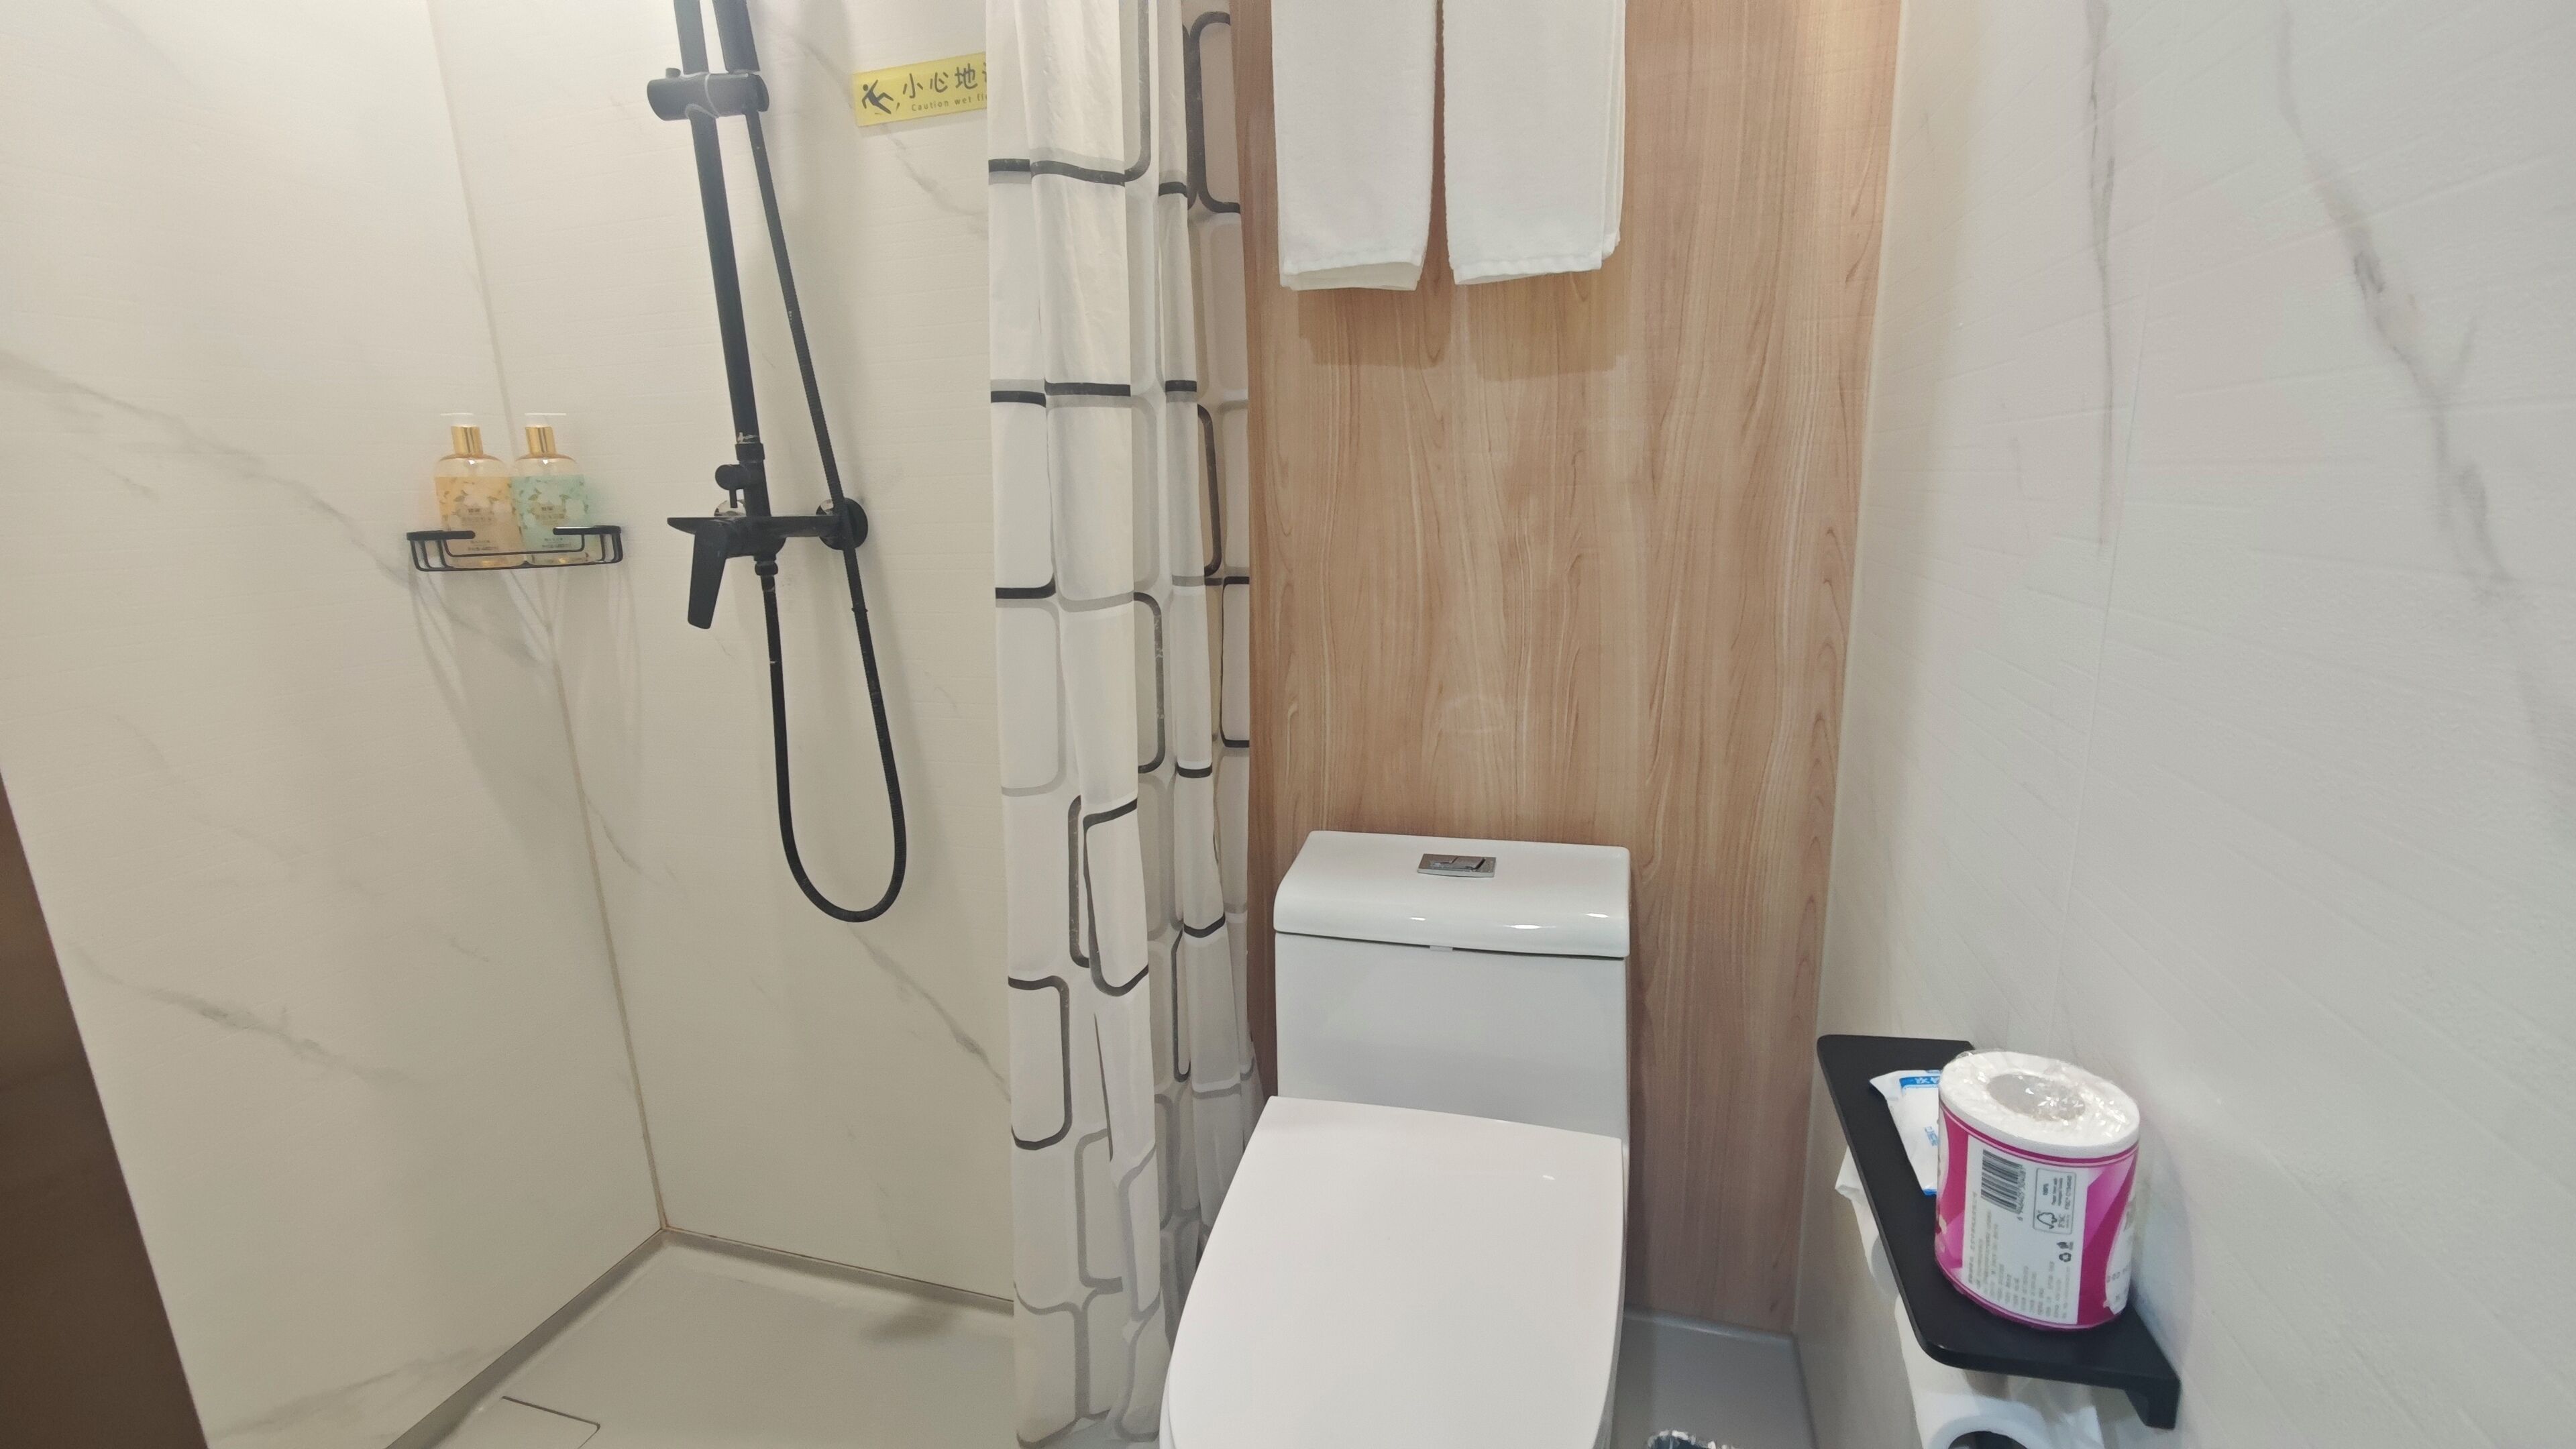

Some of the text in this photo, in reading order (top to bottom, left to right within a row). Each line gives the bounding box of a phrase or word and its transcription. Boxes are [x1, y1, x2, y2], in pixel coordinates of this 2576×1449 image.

[902, 62, 987, 99] 小心地
[912, 100, 949, 111] Caution
[954, 96, 972, 105] wet
